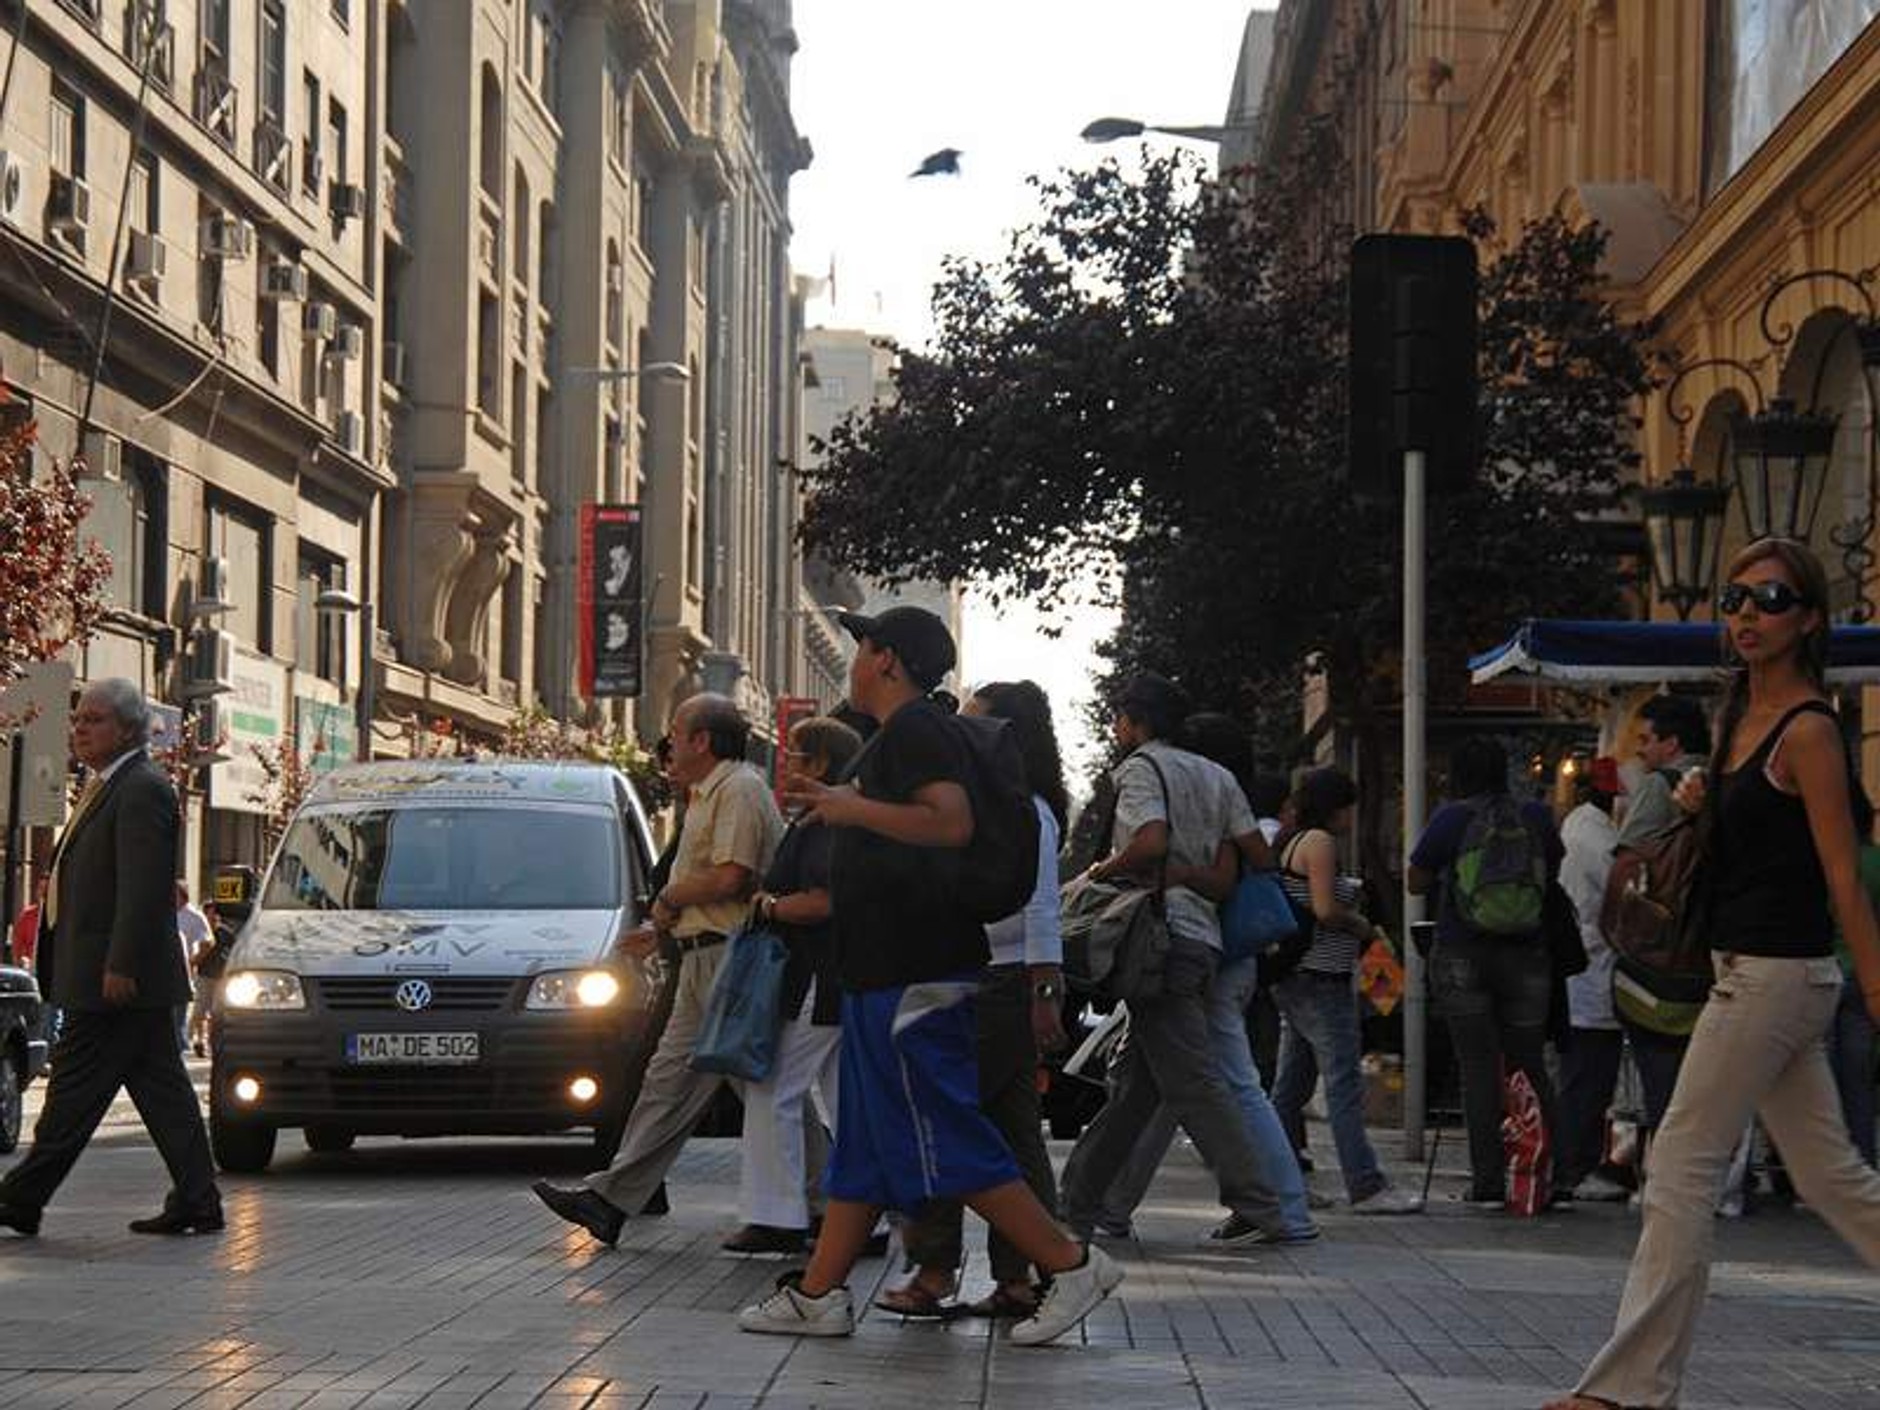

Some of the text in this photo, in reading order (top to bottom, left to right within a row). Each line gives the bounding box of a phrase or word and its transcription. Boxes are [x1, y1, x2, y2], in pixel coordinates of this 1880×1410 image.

[360, 1035, 479, 1057] MA DE 502
